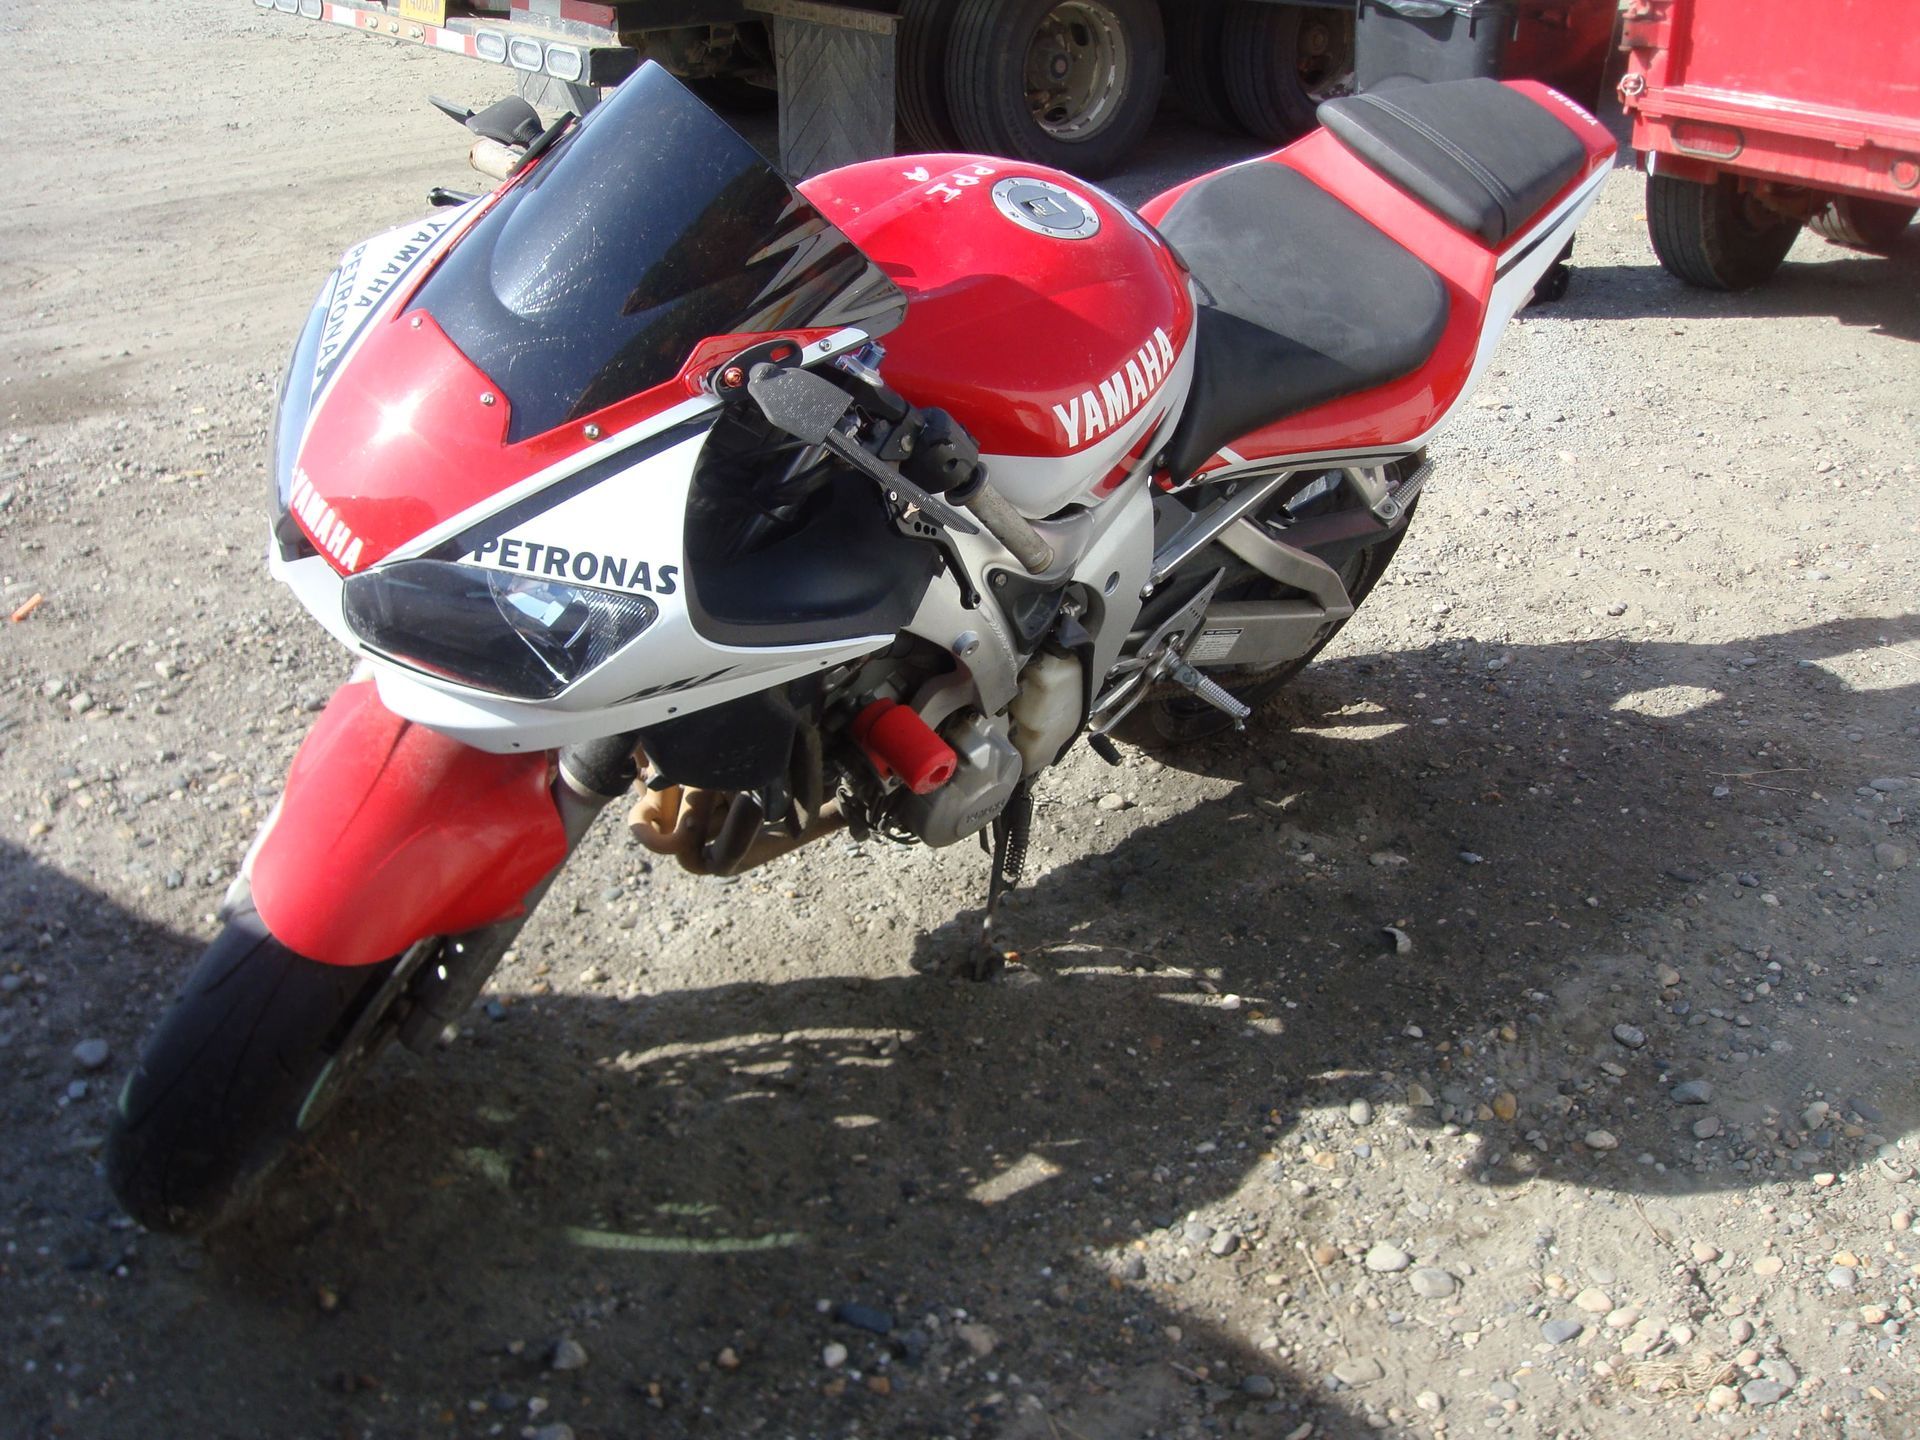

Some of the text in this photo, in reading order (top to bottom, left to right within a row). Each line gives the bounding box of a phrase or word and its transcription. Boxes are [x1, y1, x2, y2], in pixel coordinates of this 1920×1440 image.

[316, 242, 368, 378] PETRONAS
[354, 221, 447, 308] YAMAHA
[1052, 326, 1176, 449] YAMAHA
[290, 467, 364, 573] YAMAHA
[474, 537, 680, 596] PETRONAS
